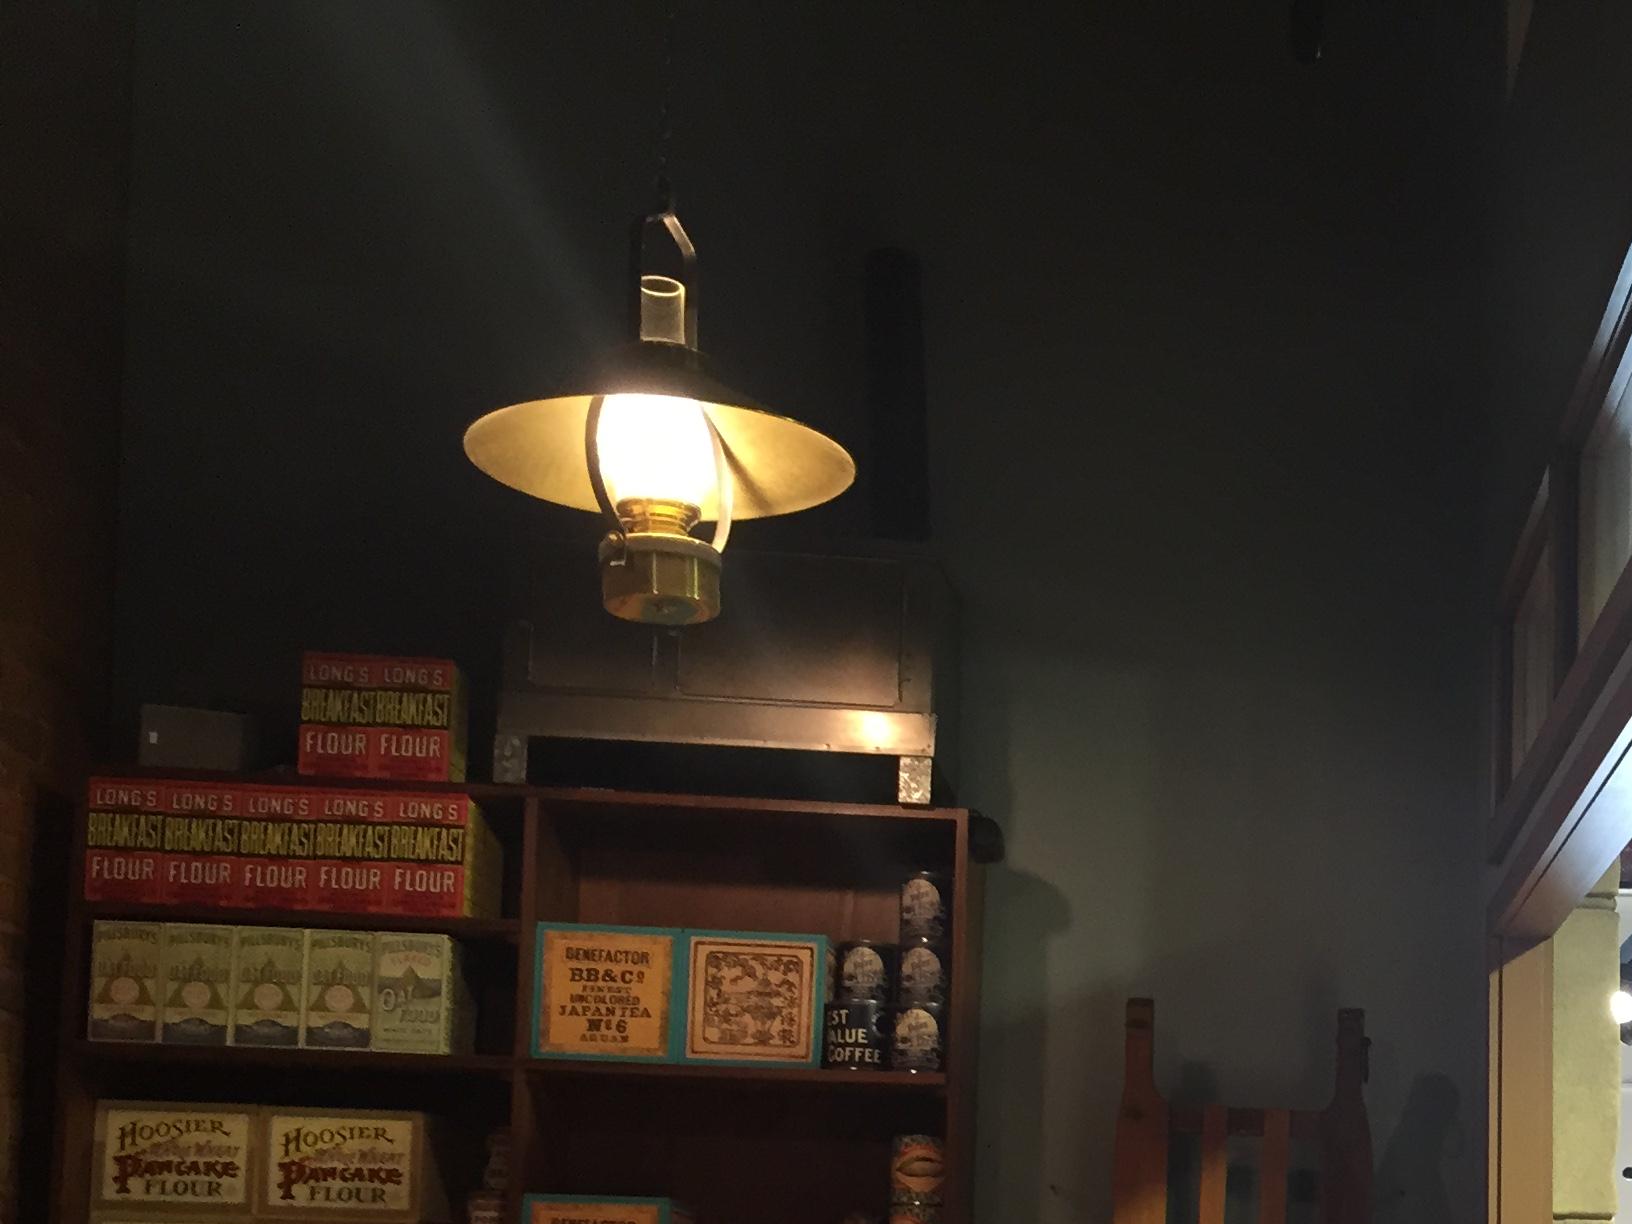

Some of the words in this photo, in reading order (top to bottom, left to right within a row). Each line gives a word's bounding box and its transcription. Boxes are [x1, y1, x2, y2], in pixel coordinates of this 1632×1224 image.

[301, 686, 376, 724] BREAKFAST
[376, 690, 449, 727] BREAKFAST
[305, 731, 367, 755] FLOUR
[380, 733, 441, 758] FLOUR
[88, 811, 163, 847] BREAKFAST
[165, 815, 242, 852] BREAKFAST
[240, 820, 316, 856] BREAKFAST
[317, 822, 390, 859] BREAKFAST
[390, 825, 464, 863] BREAKFAST
[91, 856, 154, 880] FLOUR
[168, 861, 231, 884] FLOUR
[244, 864, 307, 889] FLOUR
[319, 865, 381, 890] FLOUR
[394, 868, 455, 893] FLOUR
[559, 1005, 616, 1017] JAPAN
[620, 1007, 652, 1018] TEA
[616, 1019, 627, 1033] 6
[829, 1047, 881, 1063] COFFEE
[119, 1119, 231, 1150] HOOSIER
[281, 1126, 394, 1156] HOOSIER
[145, 1180, 222, 1197] FLOUR
[310, 1186, 386, 1203] FLOUR
